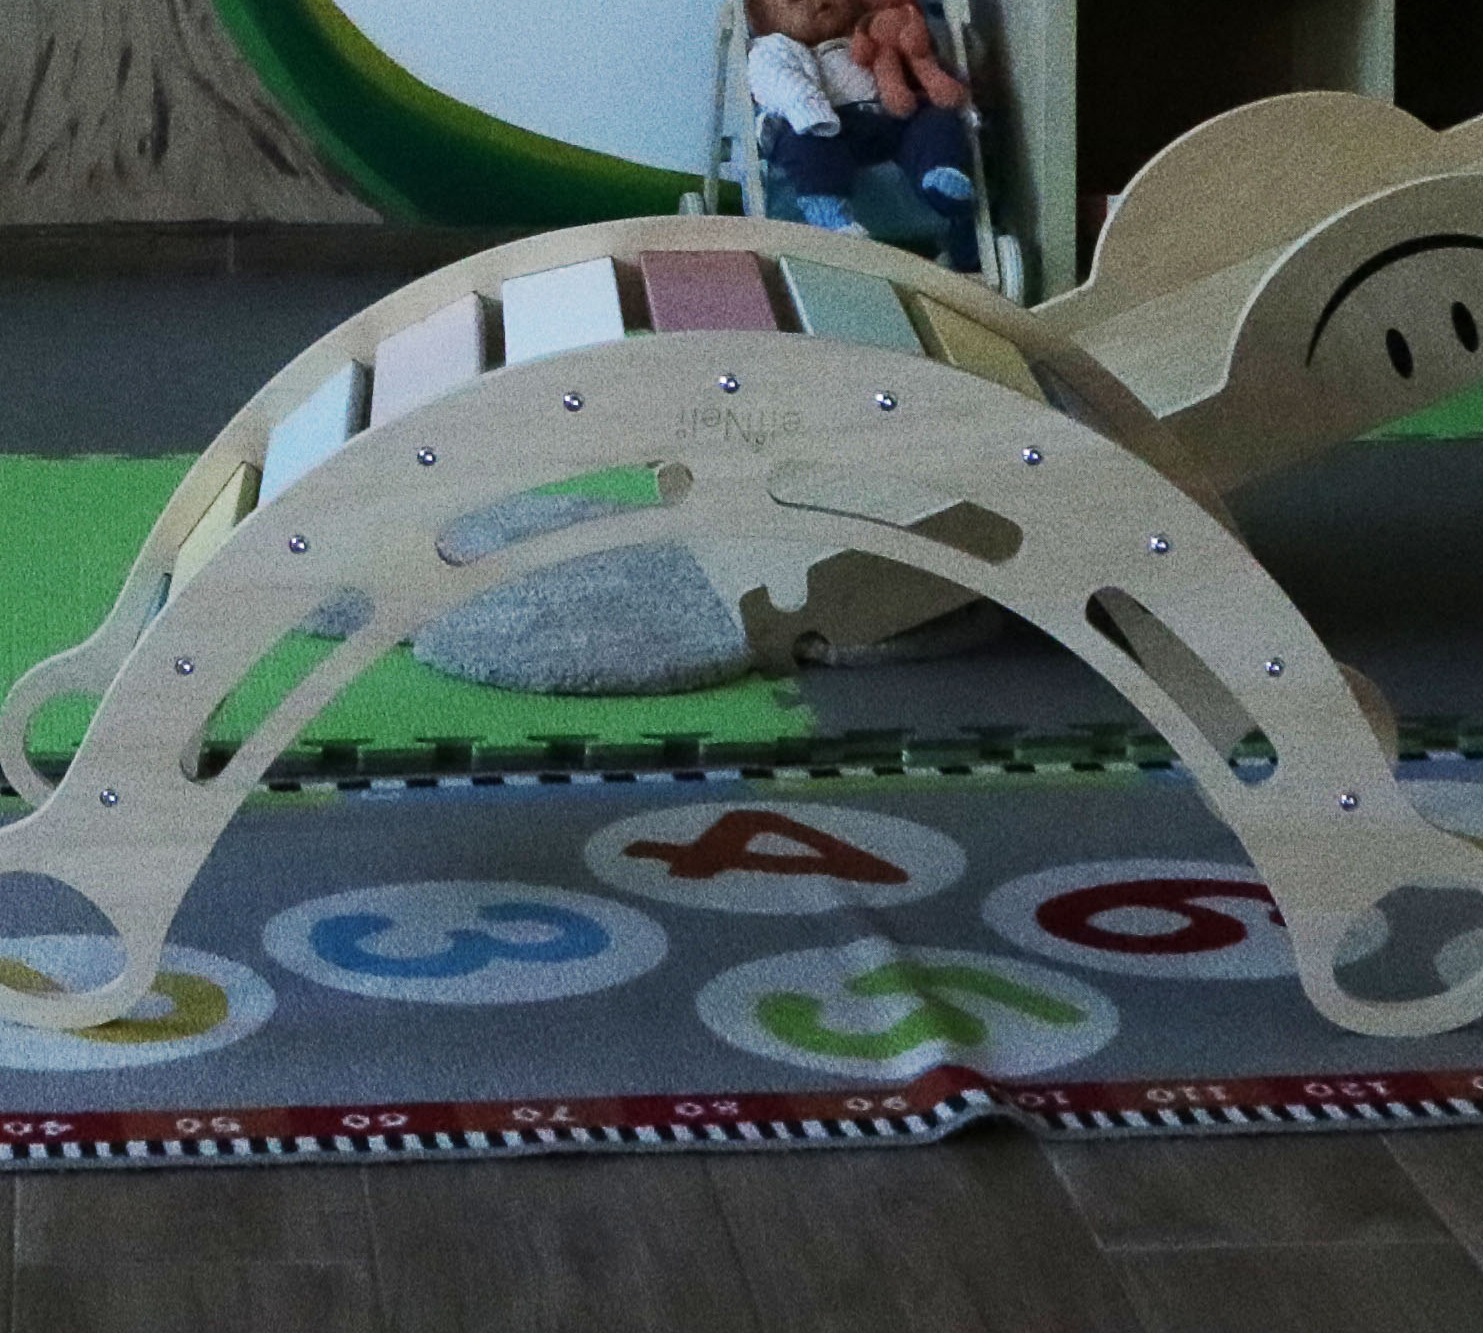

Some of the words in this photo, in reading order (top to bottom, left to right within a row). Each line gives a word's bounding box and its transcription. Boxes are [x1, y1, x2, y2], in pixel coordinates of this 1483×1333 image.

[623, 810, 909, 885] 4
[1036, 878, 1287, 954] 6
[312, 901, 612, 979] 3
[755, 961, 1087, 1059] 5
[1146, 1085, 1227, 1103] 110
[1303, 1079, 1390, 1098] 120
[674, 1100, 738, 1118] 80
[844, 1096, 910, 1112] 90
[342, 1112, 408, 1130] 60
[512, 1105, 576, 1123] 70
[3, 1119, 74, 1137] 40
[175, 1116, 242, 1134] 50
